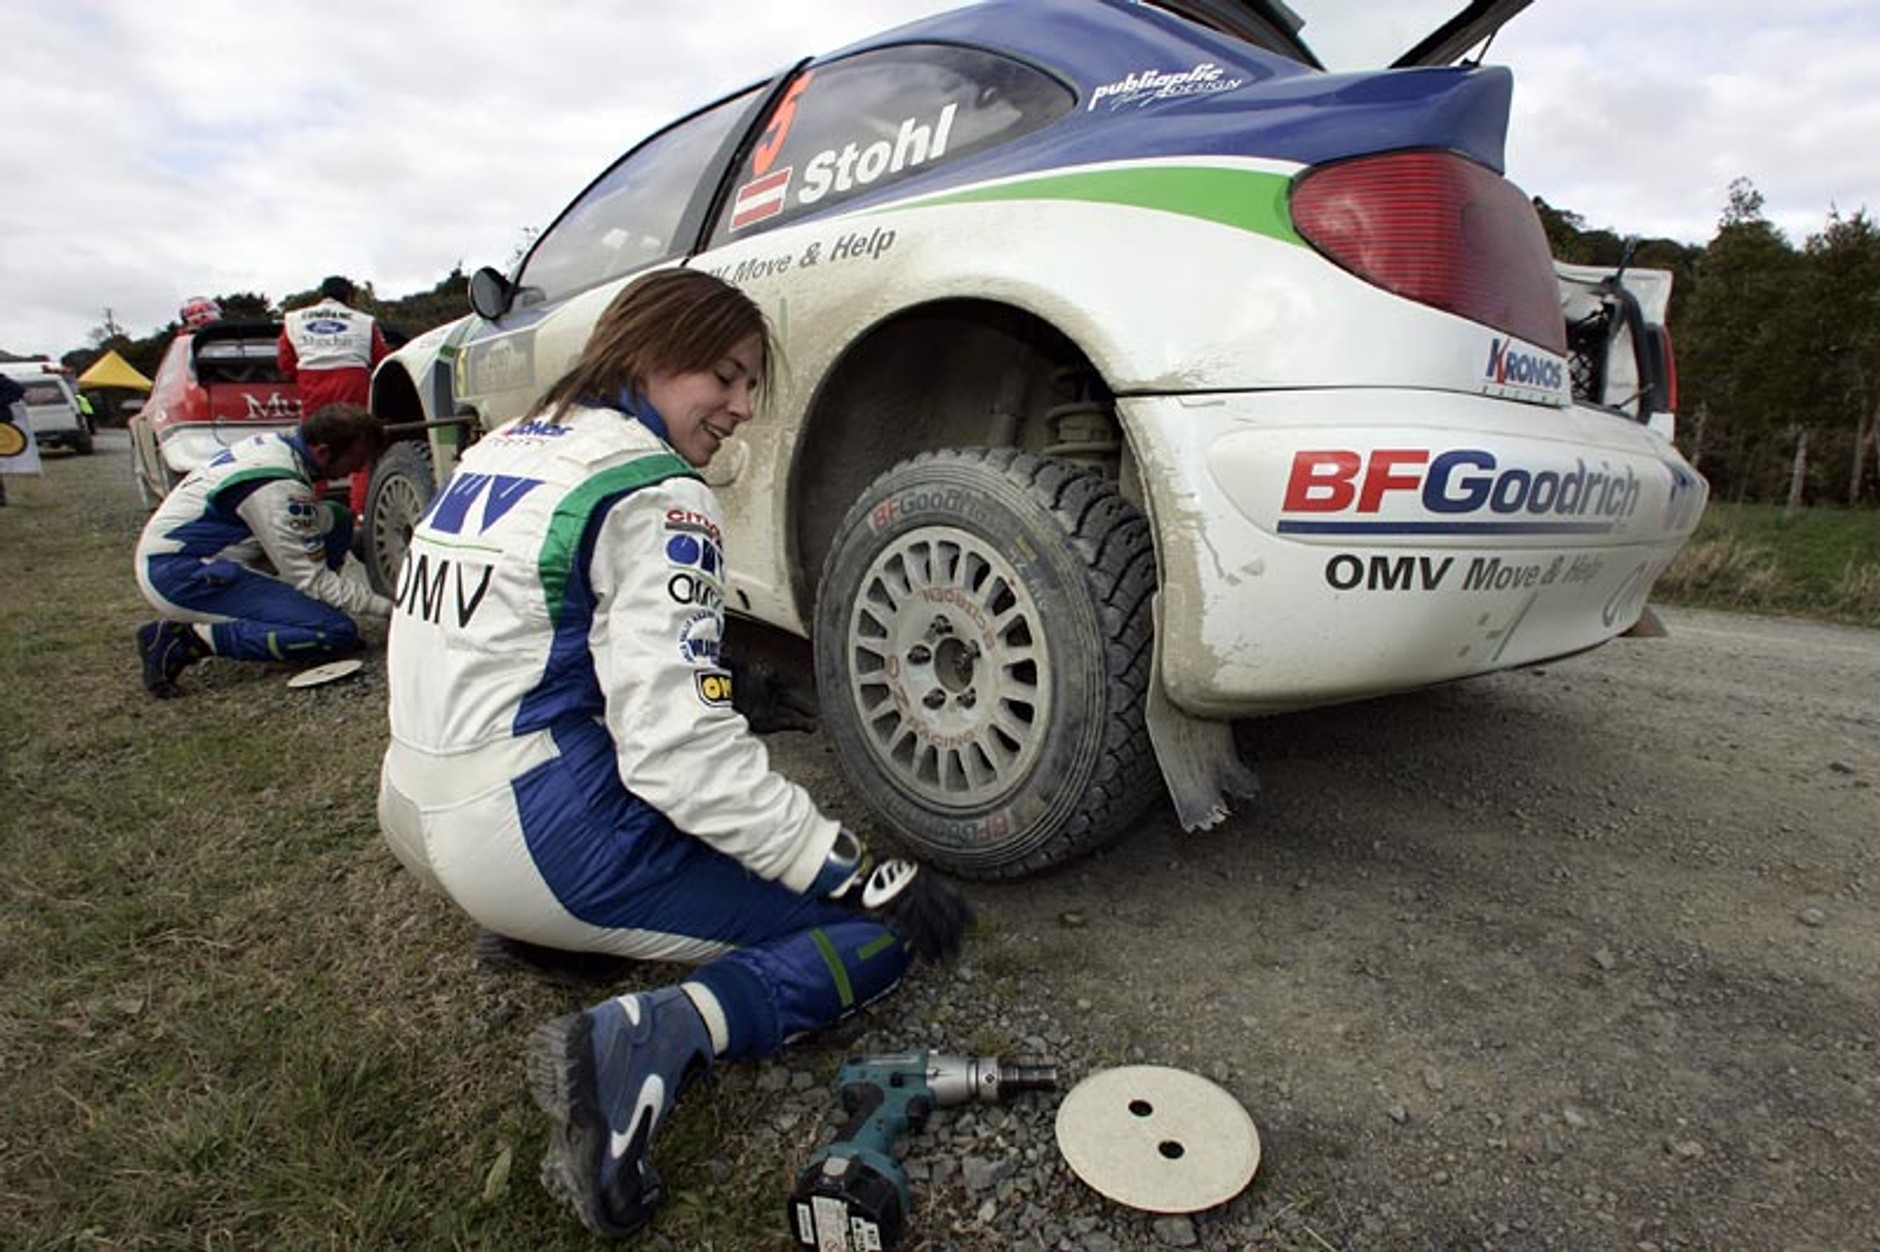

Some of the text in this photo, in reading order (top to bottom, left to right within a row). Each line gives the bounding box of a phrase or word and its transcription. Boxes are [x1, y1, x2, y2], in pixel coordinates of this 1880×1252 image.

[799, 102, 957, 203] Stohl
[734, 253, 793, 283] Move
[799, 241, 822, 268] &
[829, 226, 896, 260] Help
[1485, 338, 1562, 390] KRONOS
[242, 391, 302, 419] Mu
[1281, 449, 1640, 516] BFGoodrich
[1325, 553, 1454, 592] OMV
[1463, 556, 1540, 592] Move
[1541, 554, 1565, 585] &
